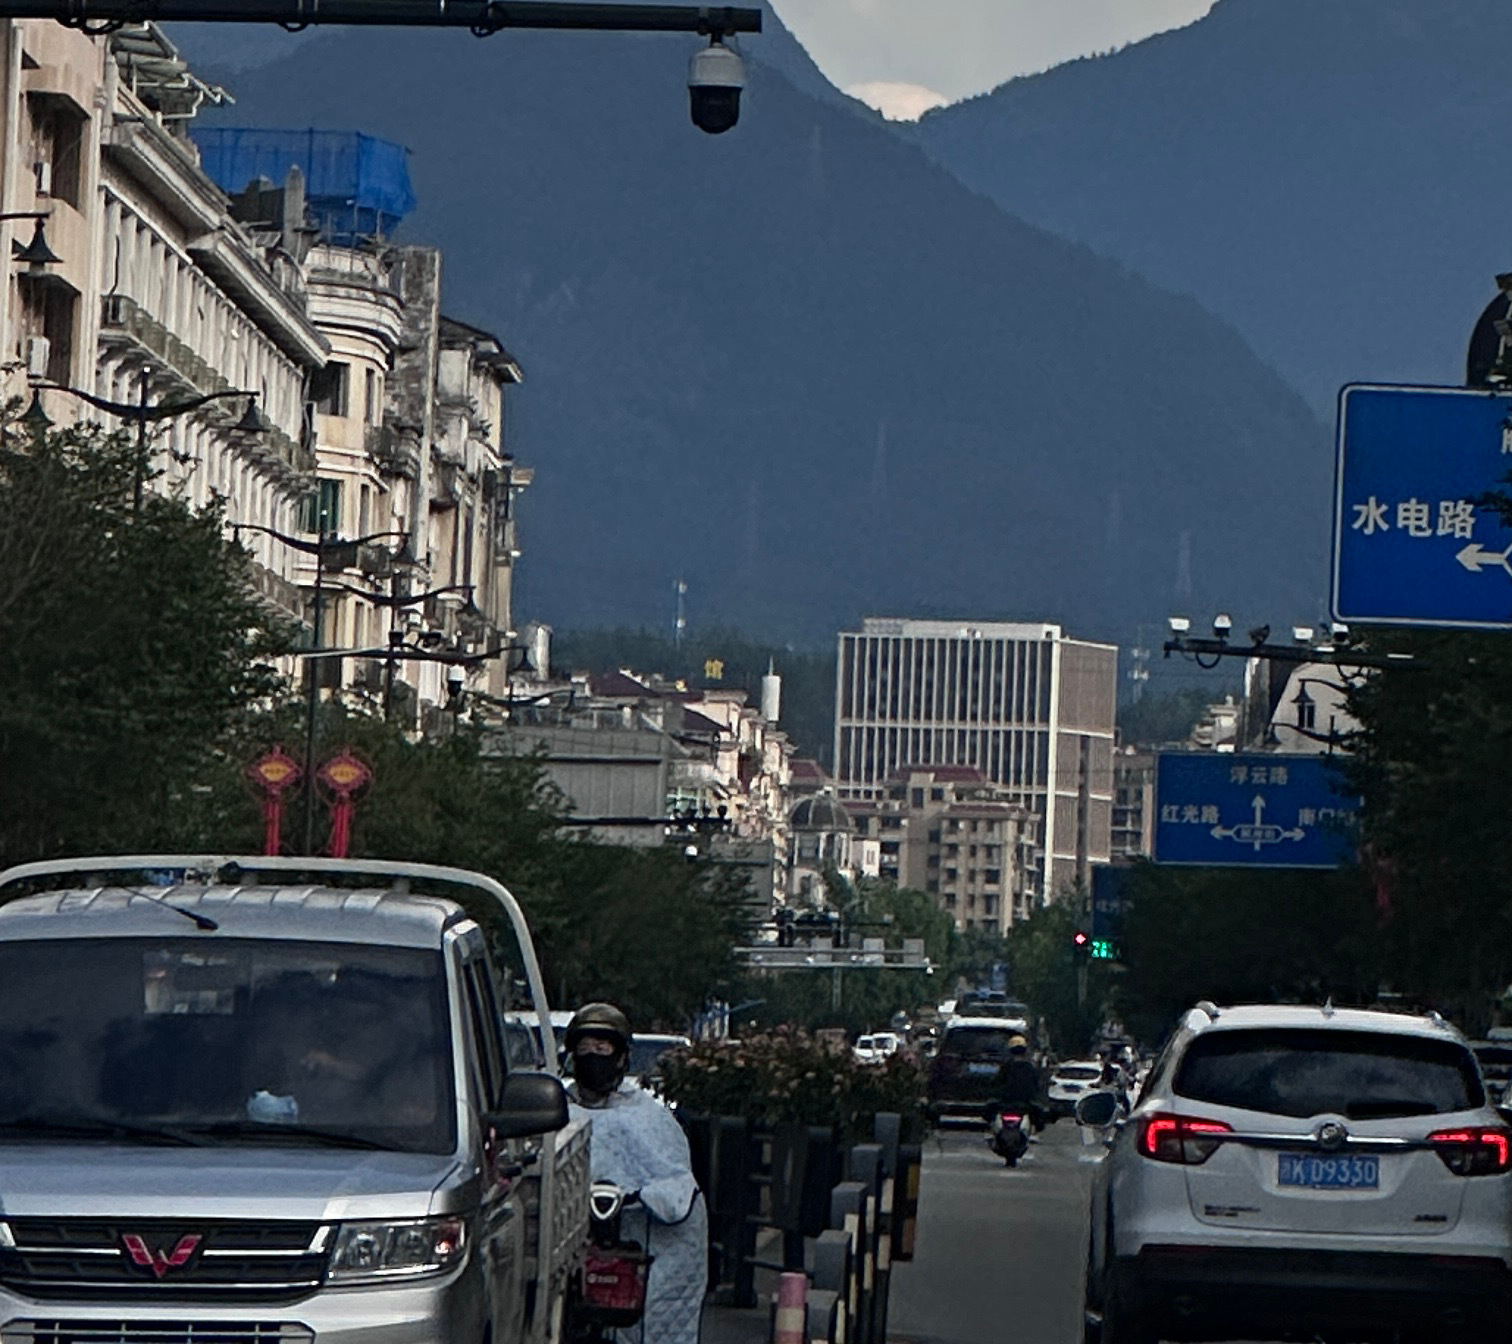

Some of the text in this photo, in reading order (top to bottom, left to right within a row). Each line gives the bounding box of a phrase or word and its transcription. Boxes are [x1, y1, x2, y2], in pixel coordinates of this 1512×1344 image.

[1351, 496, 1477, 539] 水电路
[1161, 804, 1220, 825] 红光路
